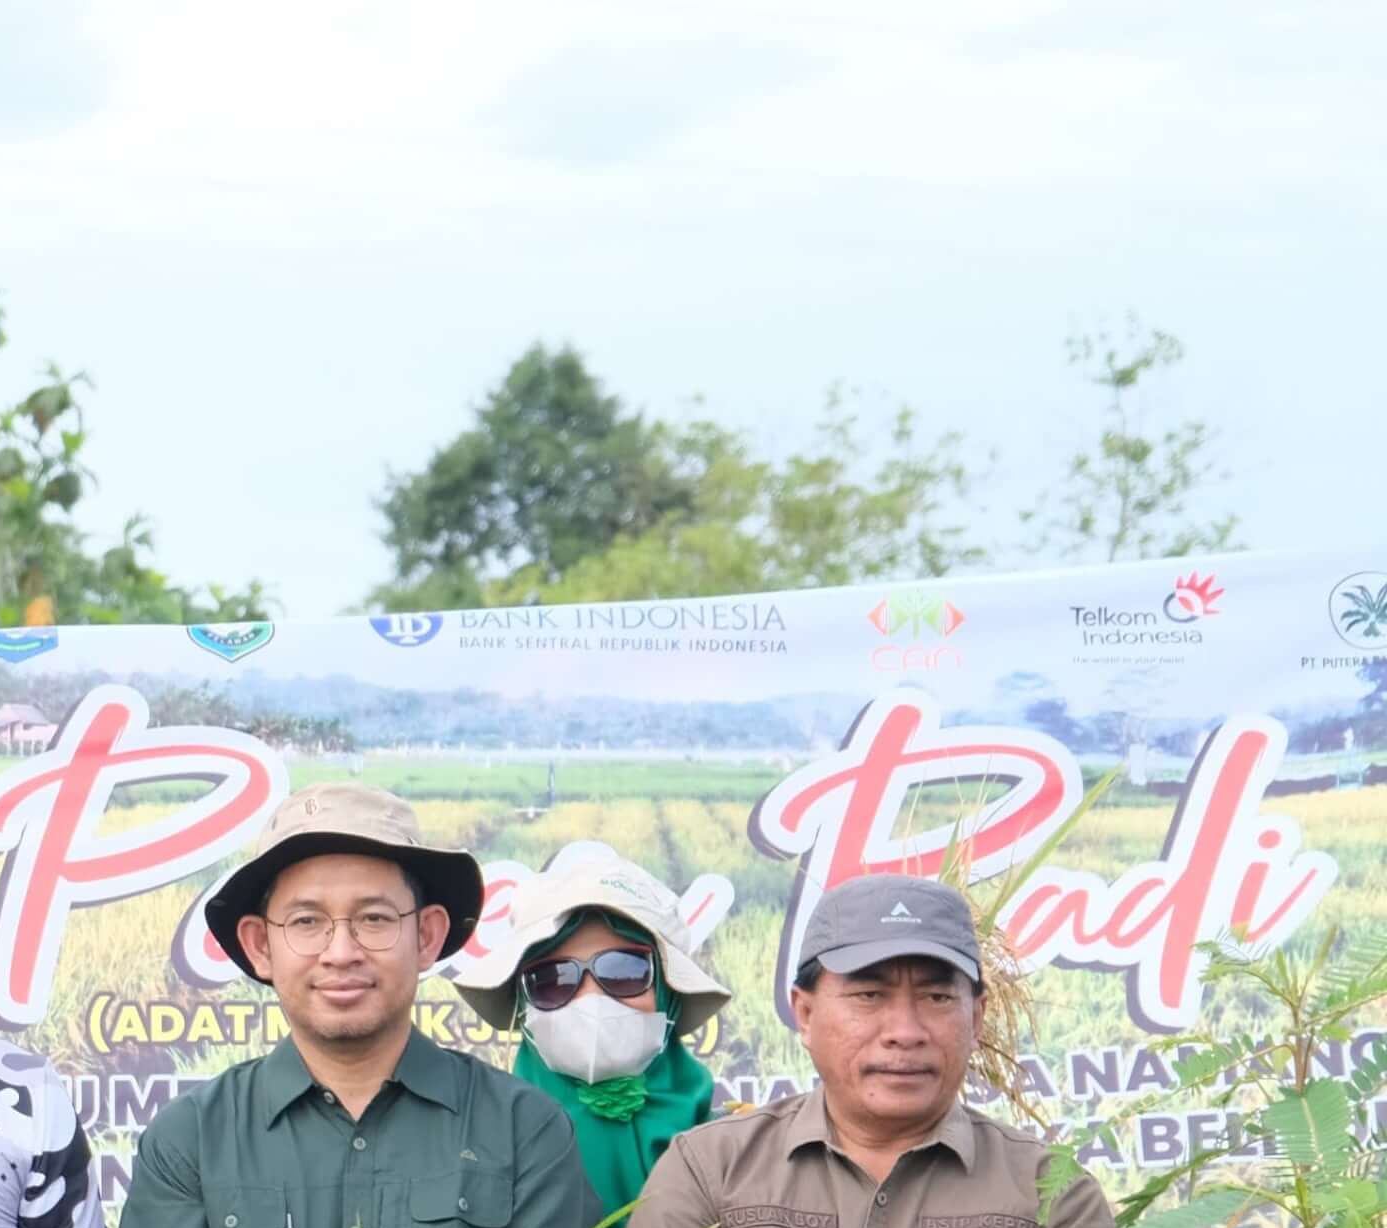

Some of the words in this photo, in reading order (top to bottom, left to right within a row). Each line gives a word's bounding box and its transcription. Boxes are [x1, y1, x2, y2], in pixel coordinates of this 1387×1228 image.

[459, 608, 559, 629] BANK
[575, 600, 788, 630] INDONESIA
[1069, 606, 1158, 627] Telkom
[458, 636, 507, 649] BANK
[514, 636, 590, 650] SENTRAL
[598, 636, 679, 652] REPUBLIK
[688, 638, 788, 653] INDONESIA
[1082, 630, 1203, 646] Indonesia
[91, 996, 256, 1054] (ADAT
[794, 1211, 830, 1228] BOY
